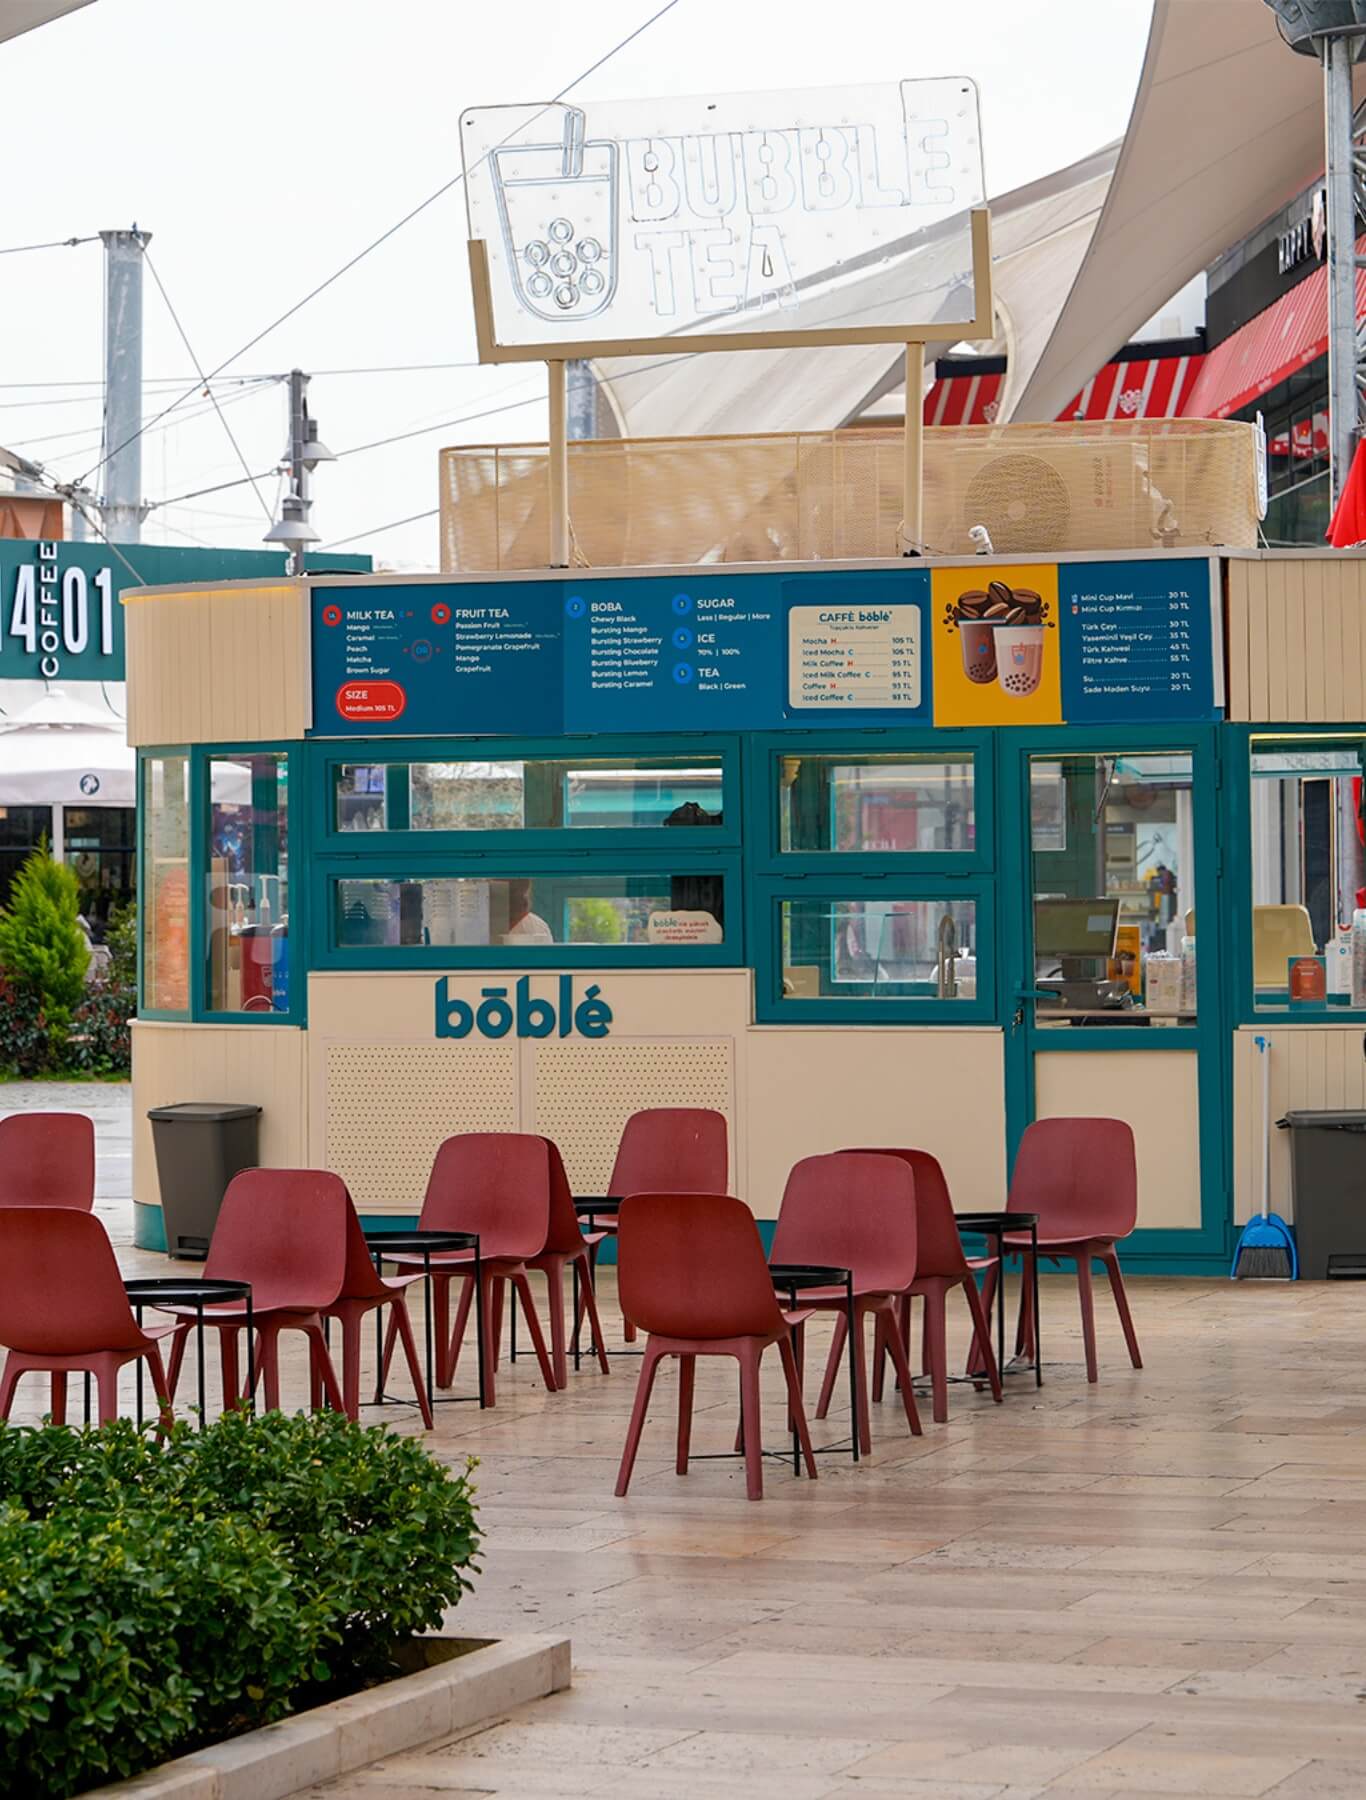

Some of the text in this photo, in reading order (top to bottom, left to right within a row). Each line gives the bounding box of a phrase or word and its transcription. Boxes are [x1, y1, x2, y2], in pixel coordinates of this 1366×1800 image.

[627, 119, 955, 222] BUBBLE
[635, 224, 798, 316] TEA
[1099, 594, 1115, 602] Cup
[1, 564, 36, 653] 4
[591, 603, 623, 612] BOBA
[697, 599, 735, 609] SUGAR
[40, 542, 59, 677] COFFEE
[455, 609, 483, 618] FRUIT
[488, 609, 510, 618] TEA
[1099, 605, 1115, 614] Cup
[346, 611, 372, 620] MILK
[375, 610, 394, 620] TEA
[591, 615, 637, 624] Chewy Black
[697, 614, 713, 622] Less
[718, 614, 747, 622] Regular
[346, 624, 370, 632] Mango
[455, 622, 482, 630] Passion
[1081, 623, 1099, 631] Türk
[1180, 620, 1189, 628] TL
[591, 626, 648, 635] Bursting Mango
[346, 634, 375, 642] Caramel
[455, 633, 494, 641] Strawberry
[495, 632, 532, 640] Lemonade
[697, 634, 716, 643] ICE
[1138, 633, 1153, 642] Çay
[591, 637, 663, 646] Bursting Strawberry
[455, 643, 540, 652] Pomegranate Grapefruit
[721, 648, 740, 656] 100%
[455, 655, 480, 663] Mango
[1181, 654, 1190, 662] TL
[591, 659, 658, 667] Bursting Blueberry
[370, 666, 390, 675] Sugar
[455, 665, 492, 673] Grapefruit
[698, 668, 720, 677] TEA
[591, 670, 622, 678] Bursting
[1171, 672, 1180, 680] 20
[1182, 672, 1191, 680] TL
[591, 680, 654, 689] Bursting Caramel
[1104, 686, 1129, 694] Maden
[1130, 686, 1151, 694] Suyu
[345, 690, 368, 700] SIZE
